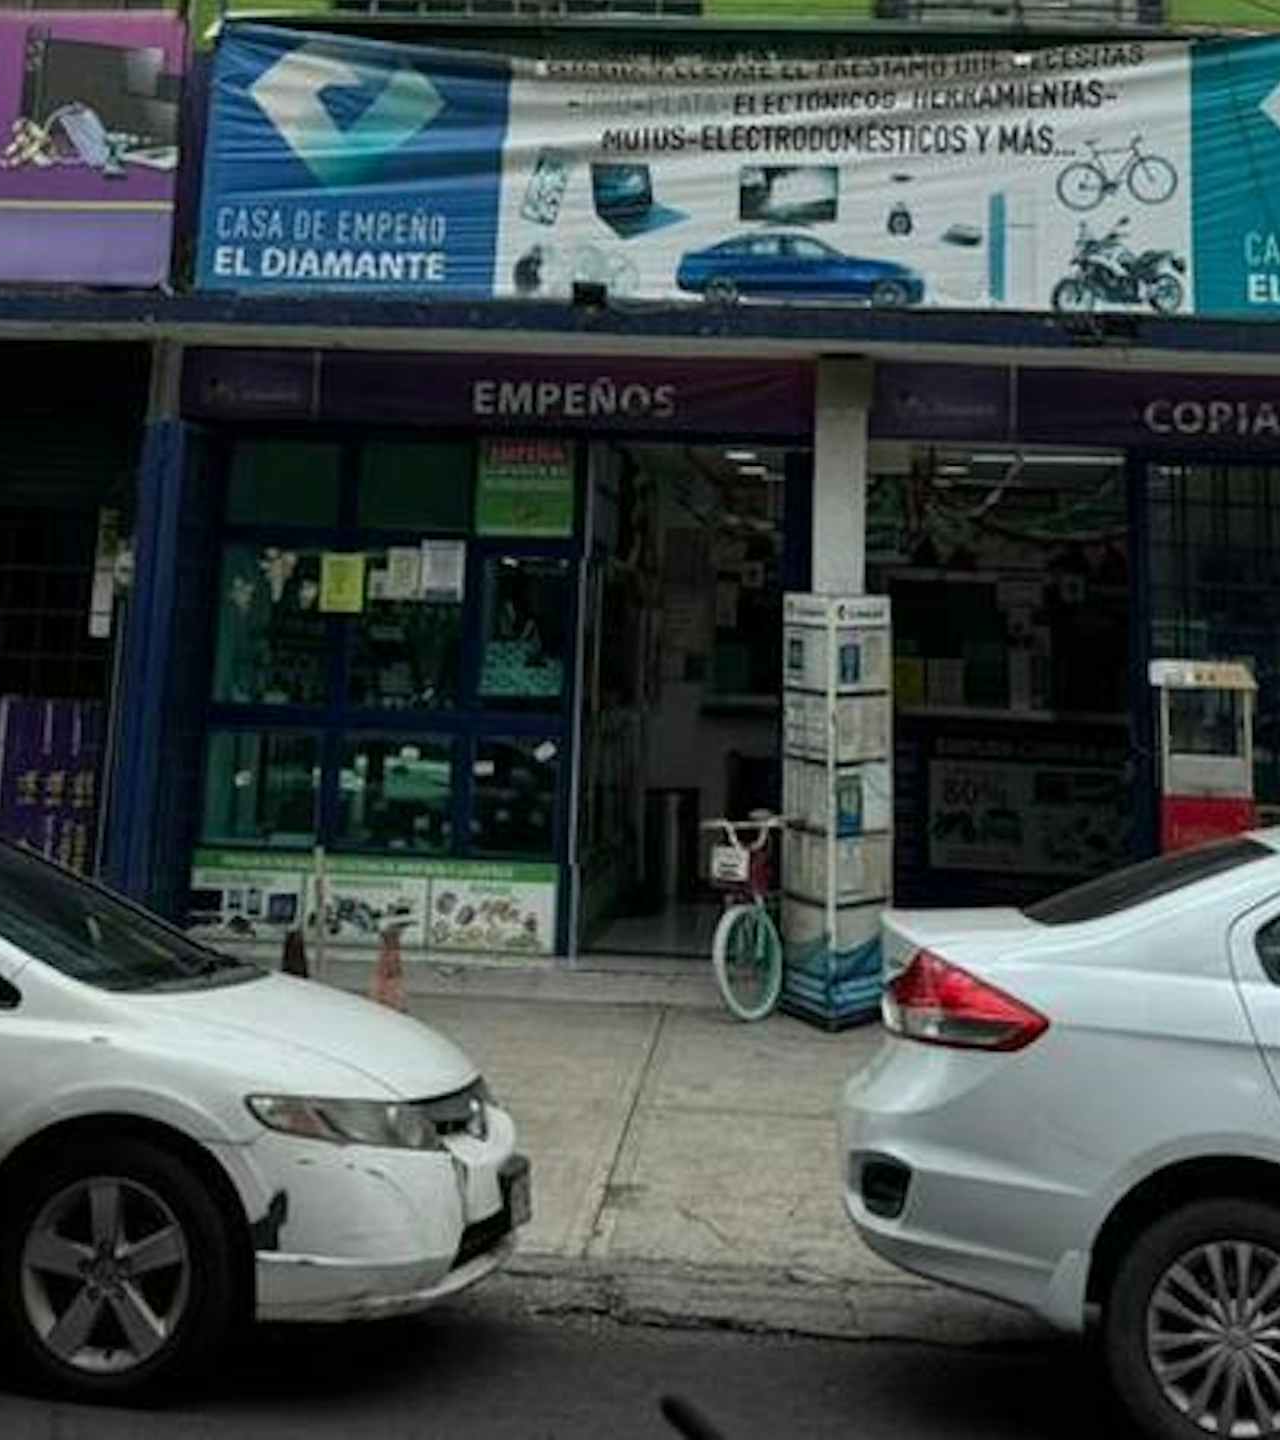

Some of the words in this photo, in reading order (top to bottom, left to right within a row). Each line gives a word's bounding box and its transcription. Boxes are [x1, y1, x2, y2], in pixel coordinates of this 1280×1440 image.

[972, 125, 993, 152] Y
[217, 208, 282, 239] CASA
[293, 211, 325, 240] DE
[214, 246, 251, 276] EL
[260, 248, 447, 282] DIAMANTE
[472, 376, 677, 418] EMPEÑOS
